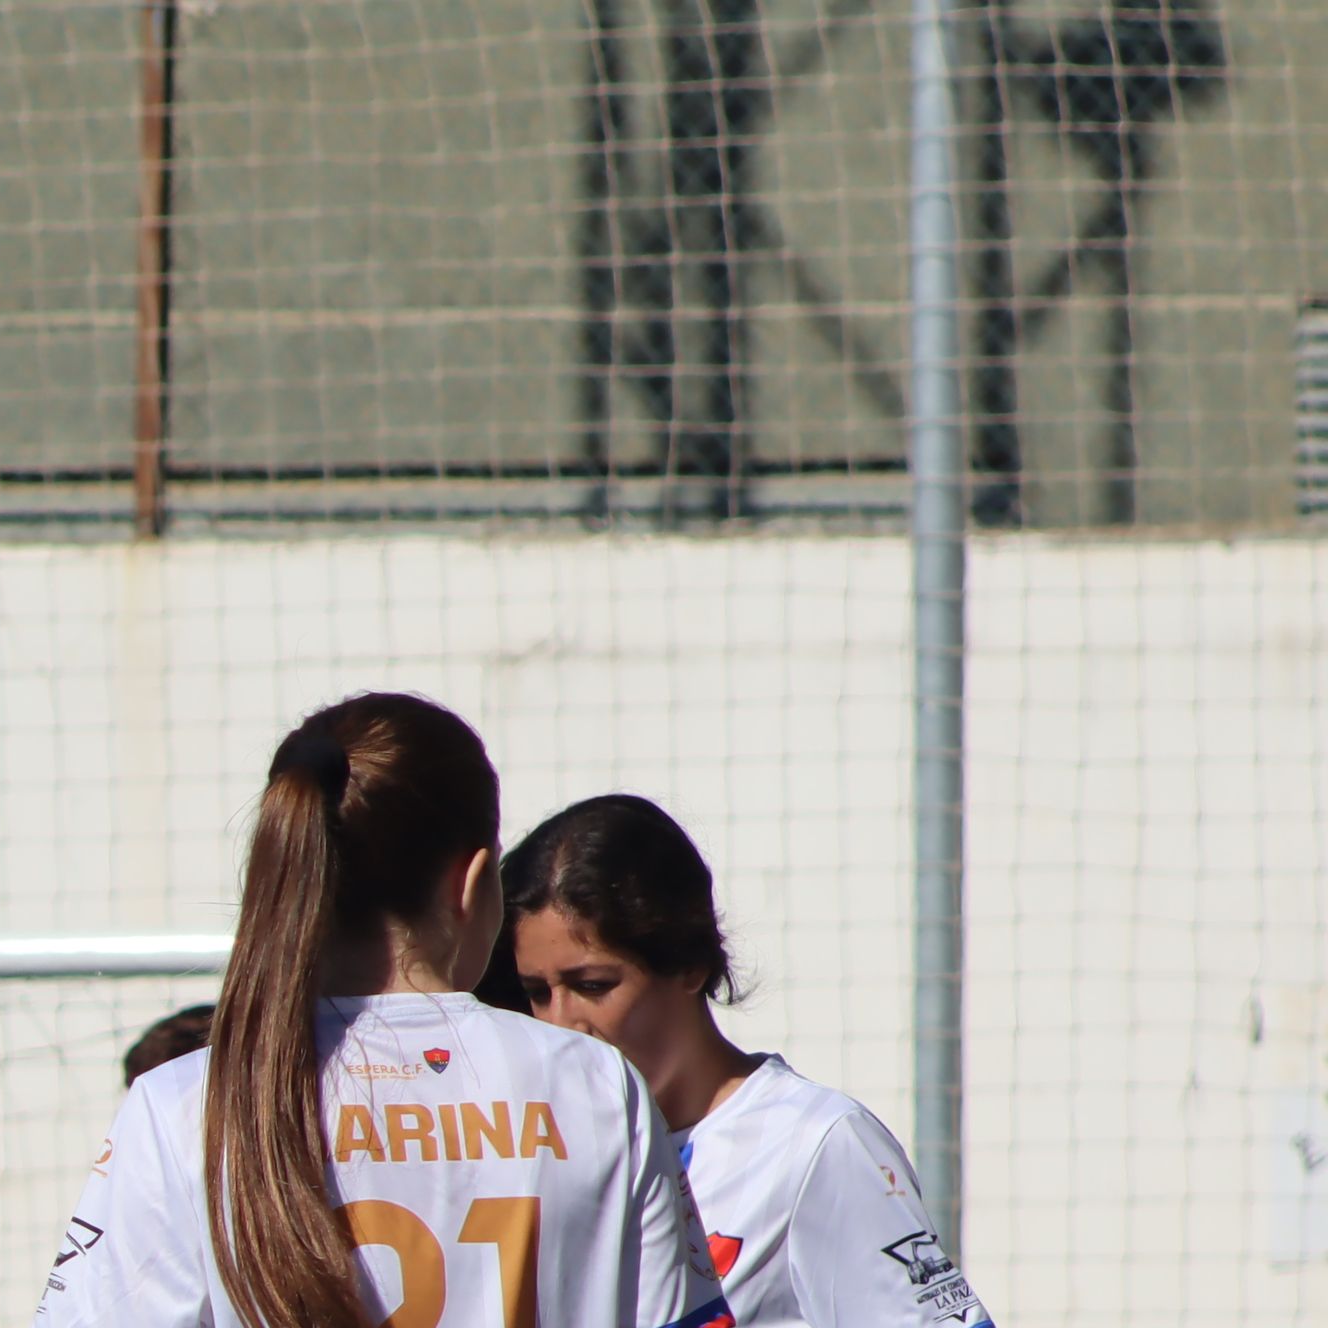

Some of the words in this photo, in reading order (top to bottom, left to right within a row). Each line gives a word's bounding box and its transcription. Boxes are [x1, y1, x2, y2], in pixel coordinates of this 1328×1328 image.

[347, 1063, 399, 1075] ESPERA
[335, 1100, 569, 1163] ARINA
[934, 1295, 952, 1309] LA
[950, 1286, 973, 1302] PAZ
